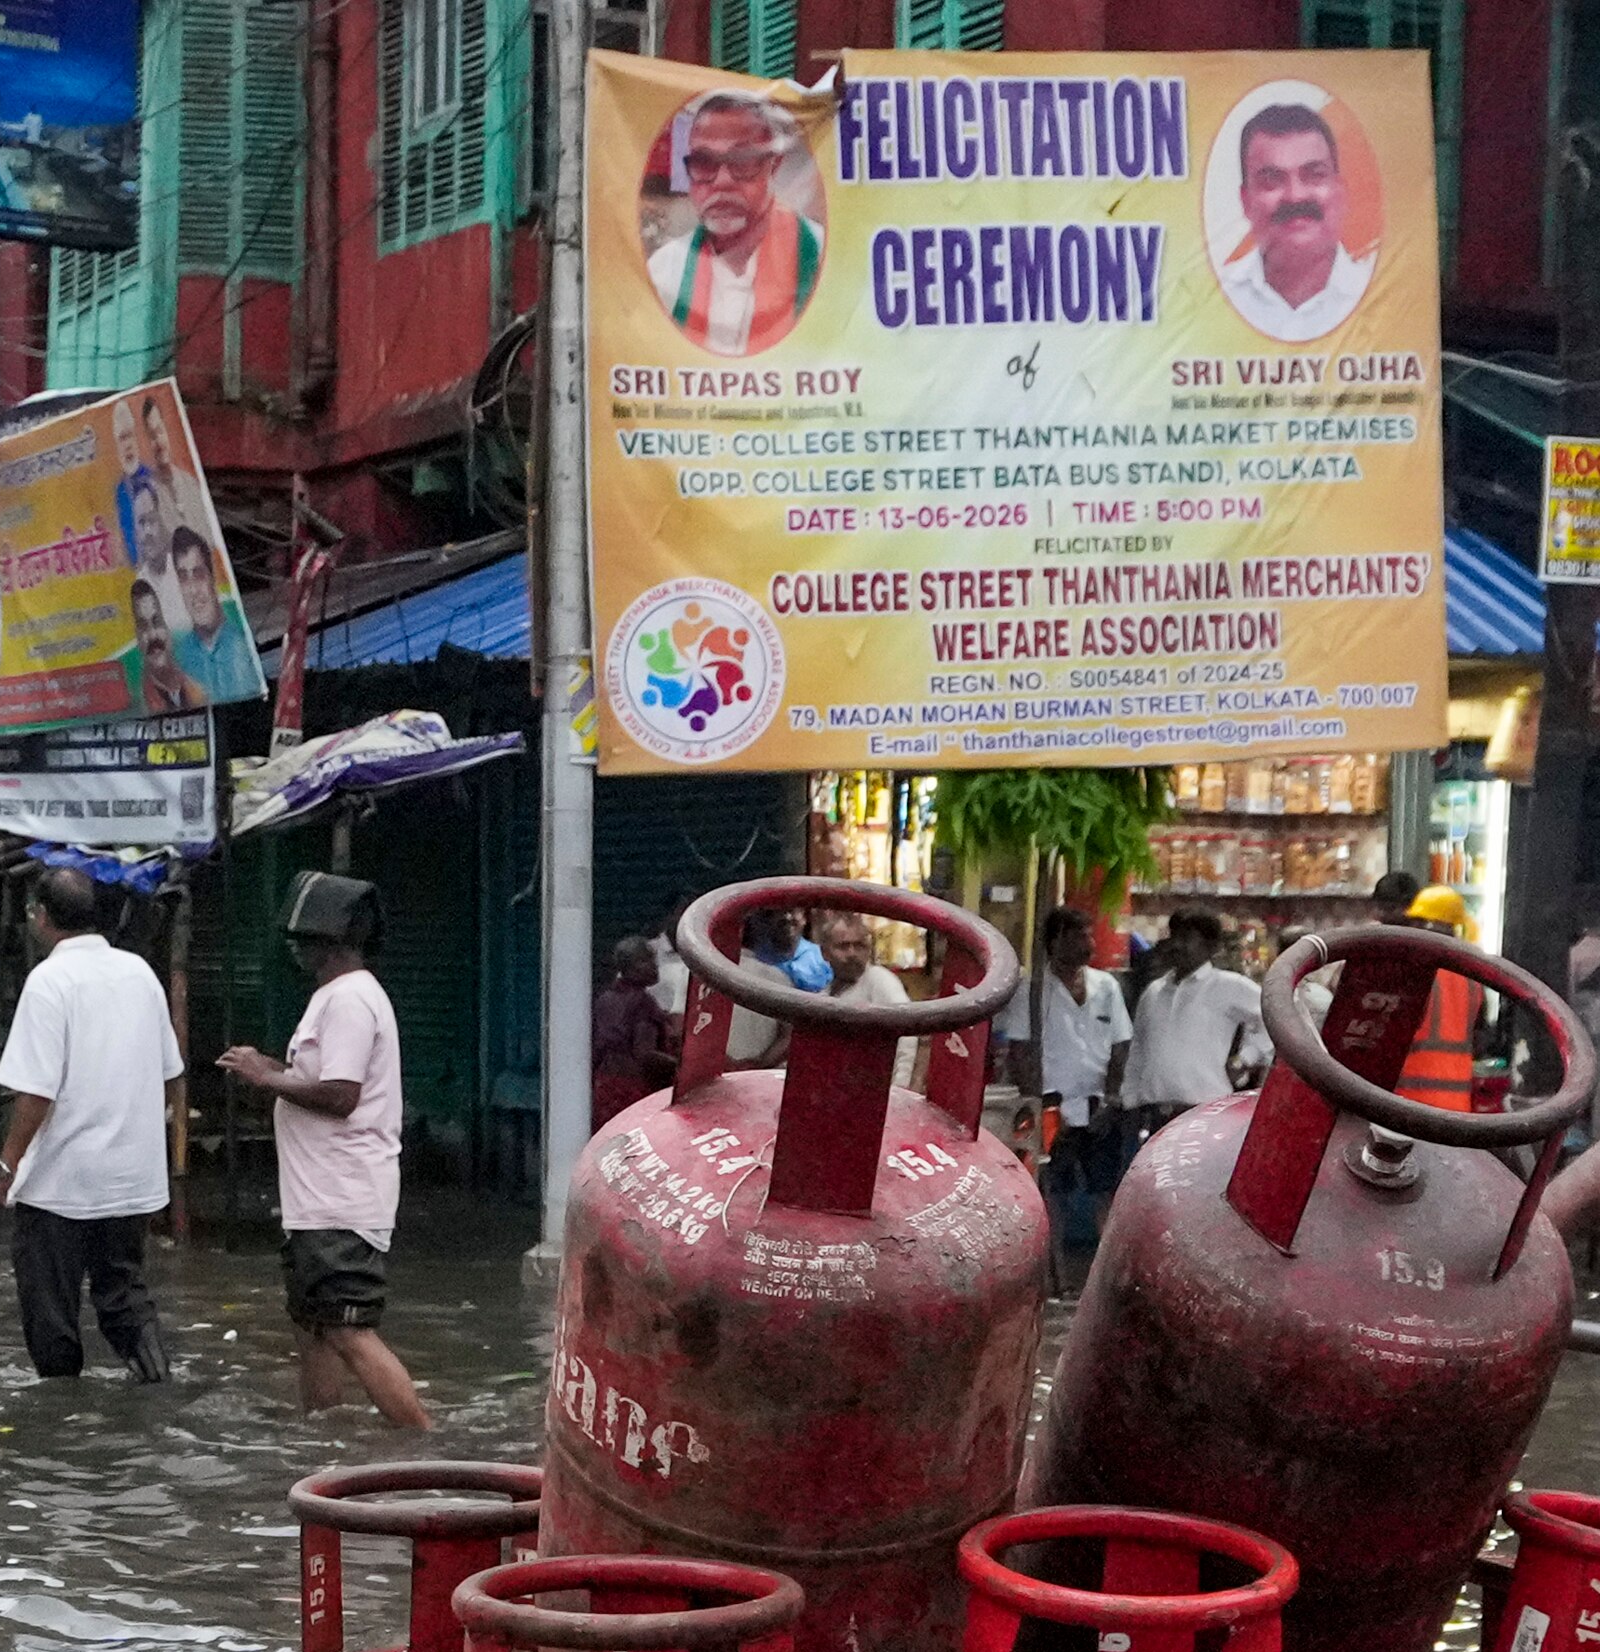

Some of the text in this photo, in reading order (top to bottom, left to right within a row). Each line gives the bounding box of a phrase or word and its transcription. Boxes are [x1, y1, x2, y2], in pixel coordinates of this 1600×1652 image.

[839, 79, 1185, 180] FELICITATION
[872, 224, 1161, 328] CEREMONY
[613, 368, 863, 396] SRI TAPAS ROY
[1007, 341, 1041, 390] of
[1171, 356, 1422, 386] SRI VIJAY OJHA
[620, 431, 712, 456] VENUE
[732, 429, 856, 456] COLLEGE
[864, 427, 967, 454] STREET
[973, 425, 1157, 452] THANTHANIA
[1167, 421, 1279, 446] MARKET
[1287, 417, 1416, 442] PREMISES
[680, 456, 1360, 495] (OPP. COLLEGE STREET BATA BUS STAND), KOLKATA
[787, 508, 857, 532] DATE
[878, 504, 1028, 529] 13-06-2026
[1072, 501, 1137, 524] TIME
[1156, 498, 1213, 522] 5:00
[1222, 497, 1262, 520] PM
[1034, 535, 1174, 554] FELICITATED BY
[772, 556, 1431, 614] COLLEGE STREET THANTHANIA MERCHANTS'
[932, 611, 1280, 663] WELFARE ASSOCIATION
[931, 674, 1001, 694] REGN.
[1009, 672, 1048, 691] NO.
[1177, 667, 1197, 684] of
[1204, 662, 1284, 682] 2024-25
[790, 708, 822, 729] 79,
[830, 705, 913, 726] MADAN
[922, 703, 1006, 723] MOHAN
[1014, 698, 1112, 721] BURMAN
[1120, 693, 1210, 716] STREET,
[1217, 687, 1319, 711] KOLKATA
[1338, 686, 1374, 707] 700
[1379, 685, 1418, 707] 007
[869, 717, 1344, 756] E-mail thanthaniacollegestreet@gmail.com
[690, 1127, 756, 1175] 15.4
[886, 1143, 959, 1182] 15.4
[741, 1279, 792, 1298] WEIGHT
[1375, 1248, 1445, 1291] 15.9
[310, 1553, 326, 1626] 15.5
